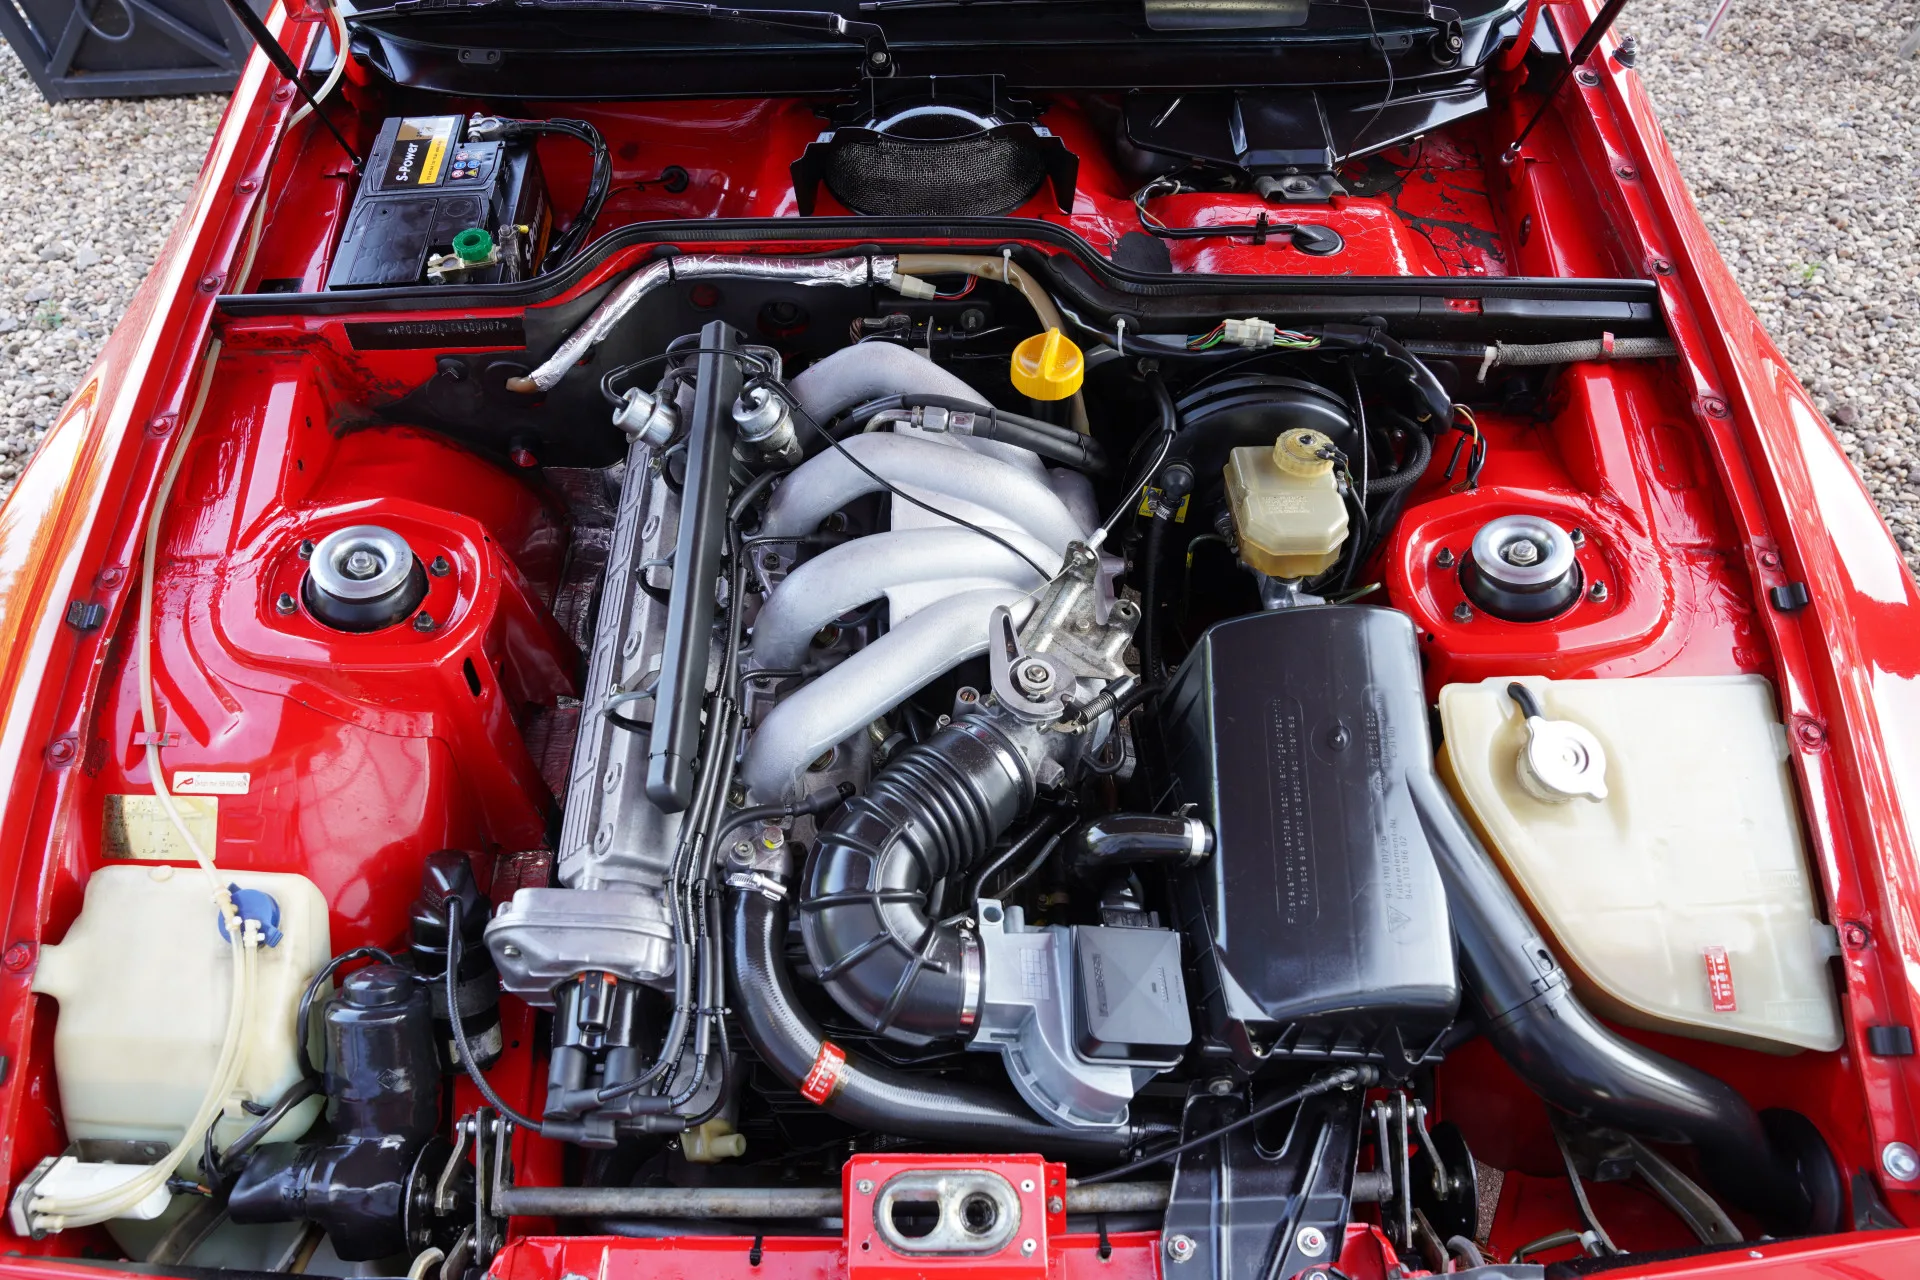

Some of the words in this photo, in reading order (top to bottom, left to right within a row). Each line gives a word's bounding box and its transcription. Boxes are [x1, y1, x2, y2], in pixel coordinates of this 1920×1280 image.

[396, 142, 418, 182] S-Power
[1291, 761, 1302, 802] specified
[1296, 822, 1307, 860] element
[1400, 836, 1406, 846] 02
[1299, 867, 1310, 904] Replace
[1092, 953, 1105, 987] BOSCH
[665, 1071, 675, 1086] BERU
[694, 1063, 704, 1082] BERU
